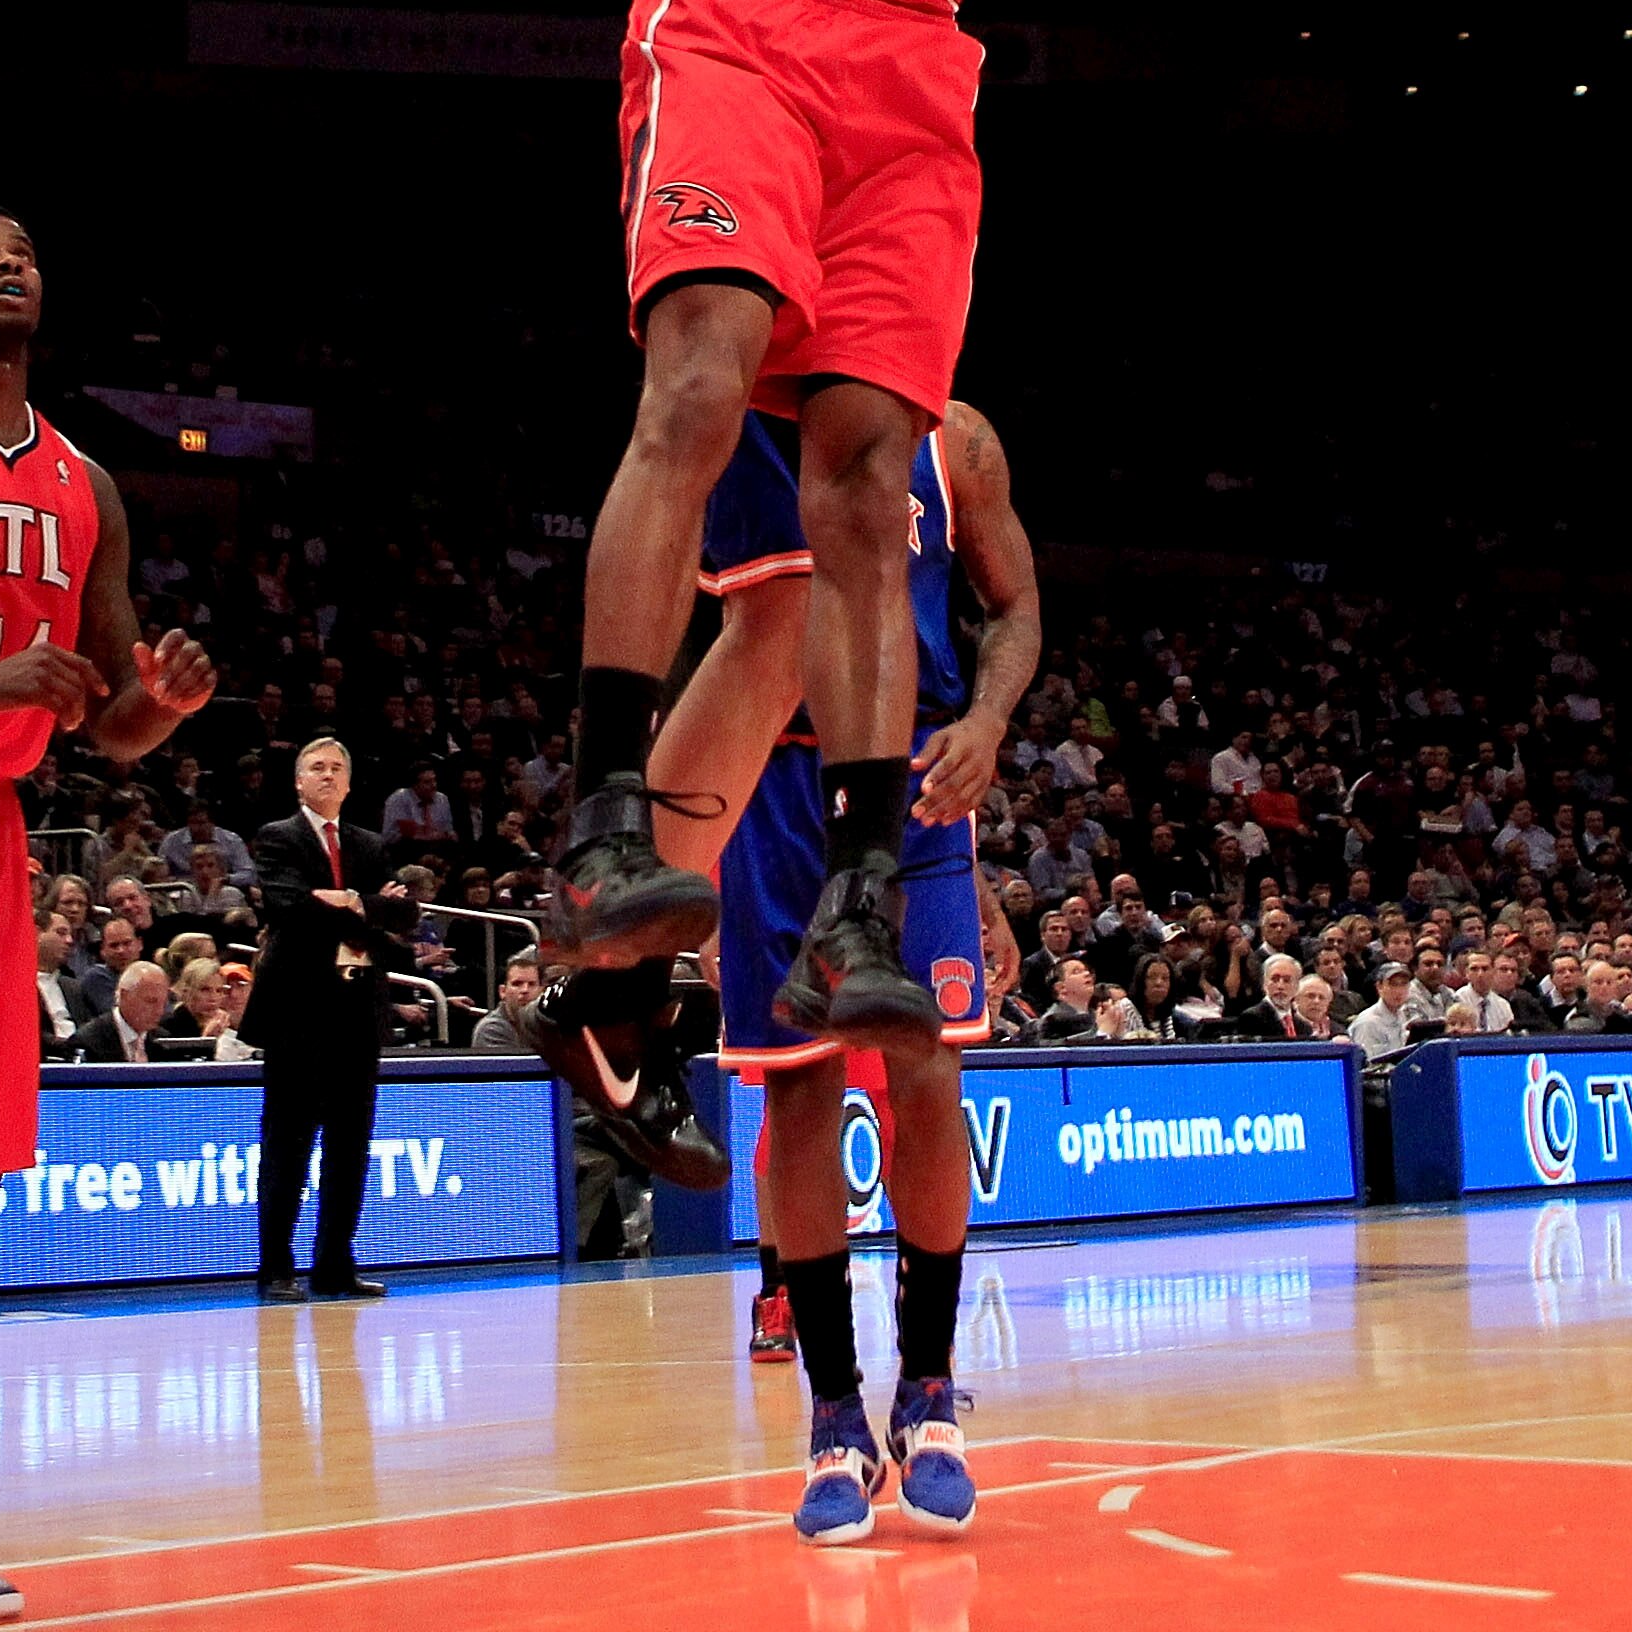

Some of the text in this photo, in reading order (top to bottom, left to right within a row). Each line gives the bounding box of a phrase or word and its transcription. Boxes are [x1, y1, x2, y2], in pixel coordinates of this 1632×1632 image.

[542, 512, 587, 540] 126
[1291, 560, 1329, 584] 127
[1058, 1106, 1306, 1174] optimum.com
[22, 1148, 143, 1213] free
[368, 1137, 464, 1199] TV.
